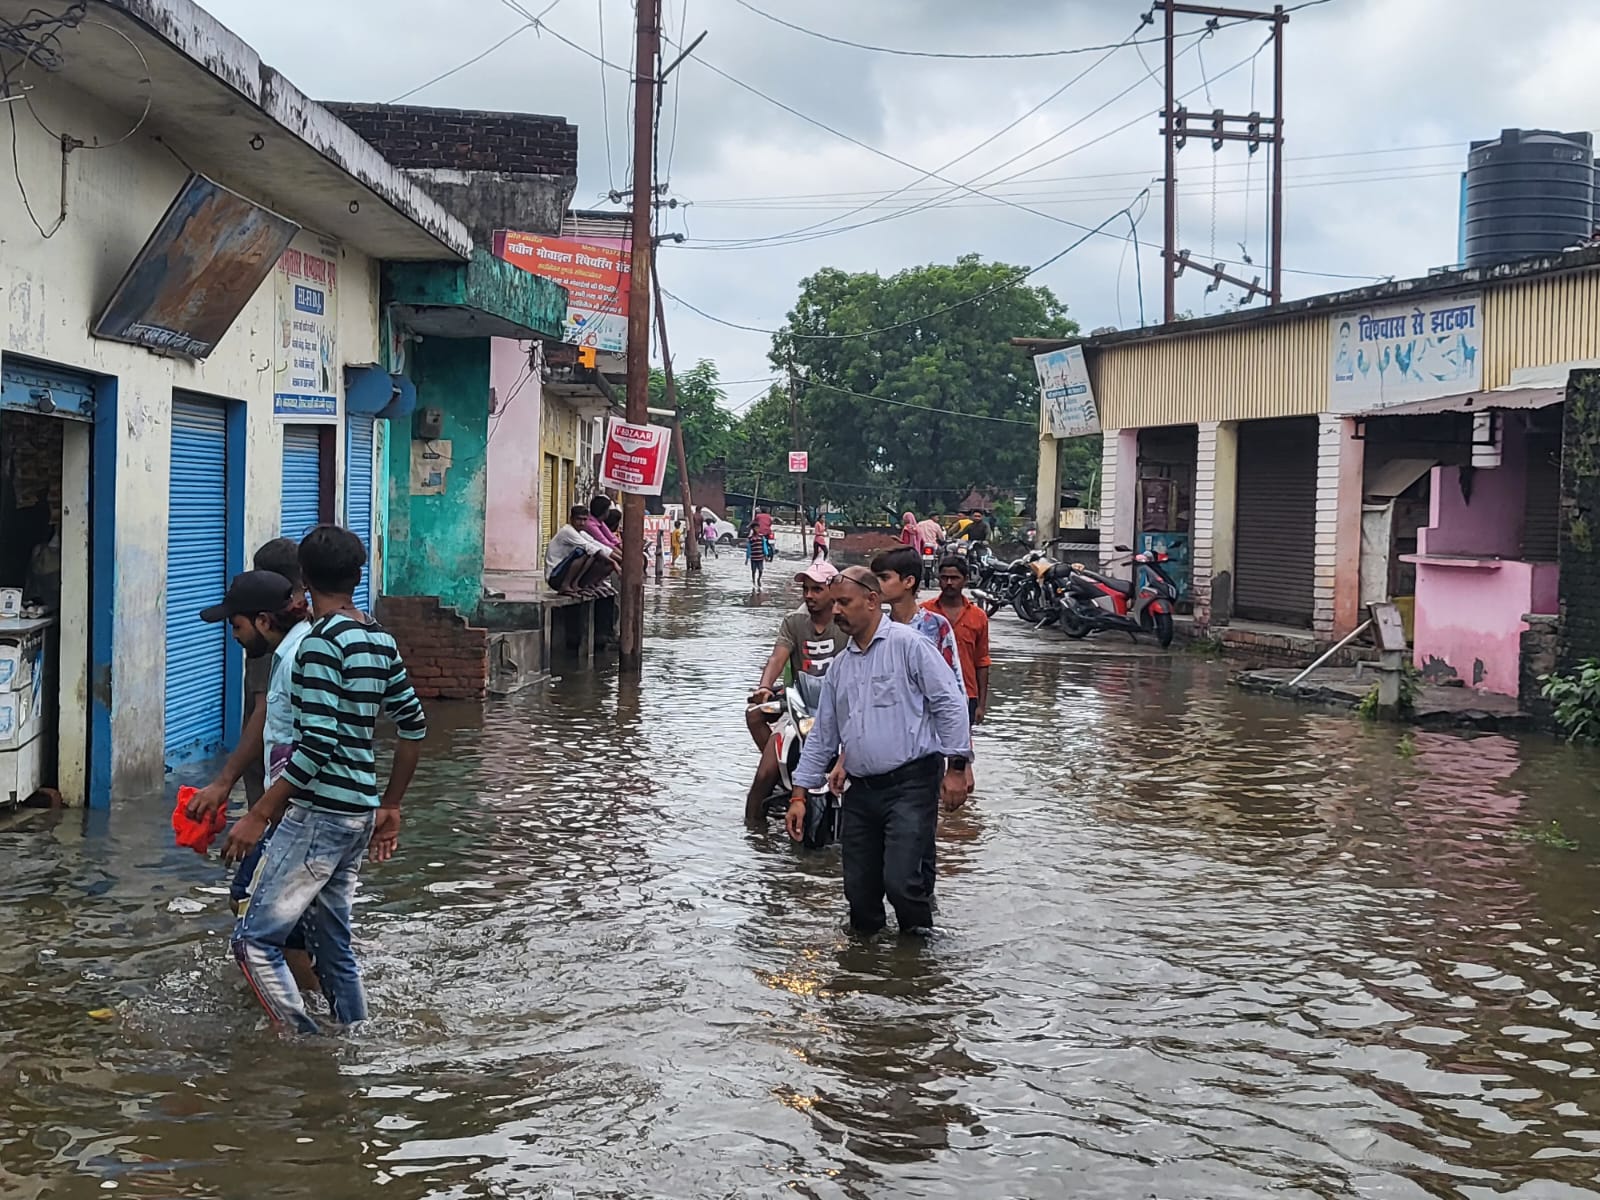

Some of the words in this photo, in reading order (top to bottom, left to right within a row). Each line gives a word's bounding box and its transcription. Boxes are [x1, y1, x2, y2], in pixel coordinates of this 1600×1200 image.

[508, 243, 534, 257] नवीन
[1358, 314, 1407, 343] विश्वास
[1411, 307, 1425, 336] से
[1430, 304, 1476, 334] झटका
[643, 518, 670, 531] ATM
